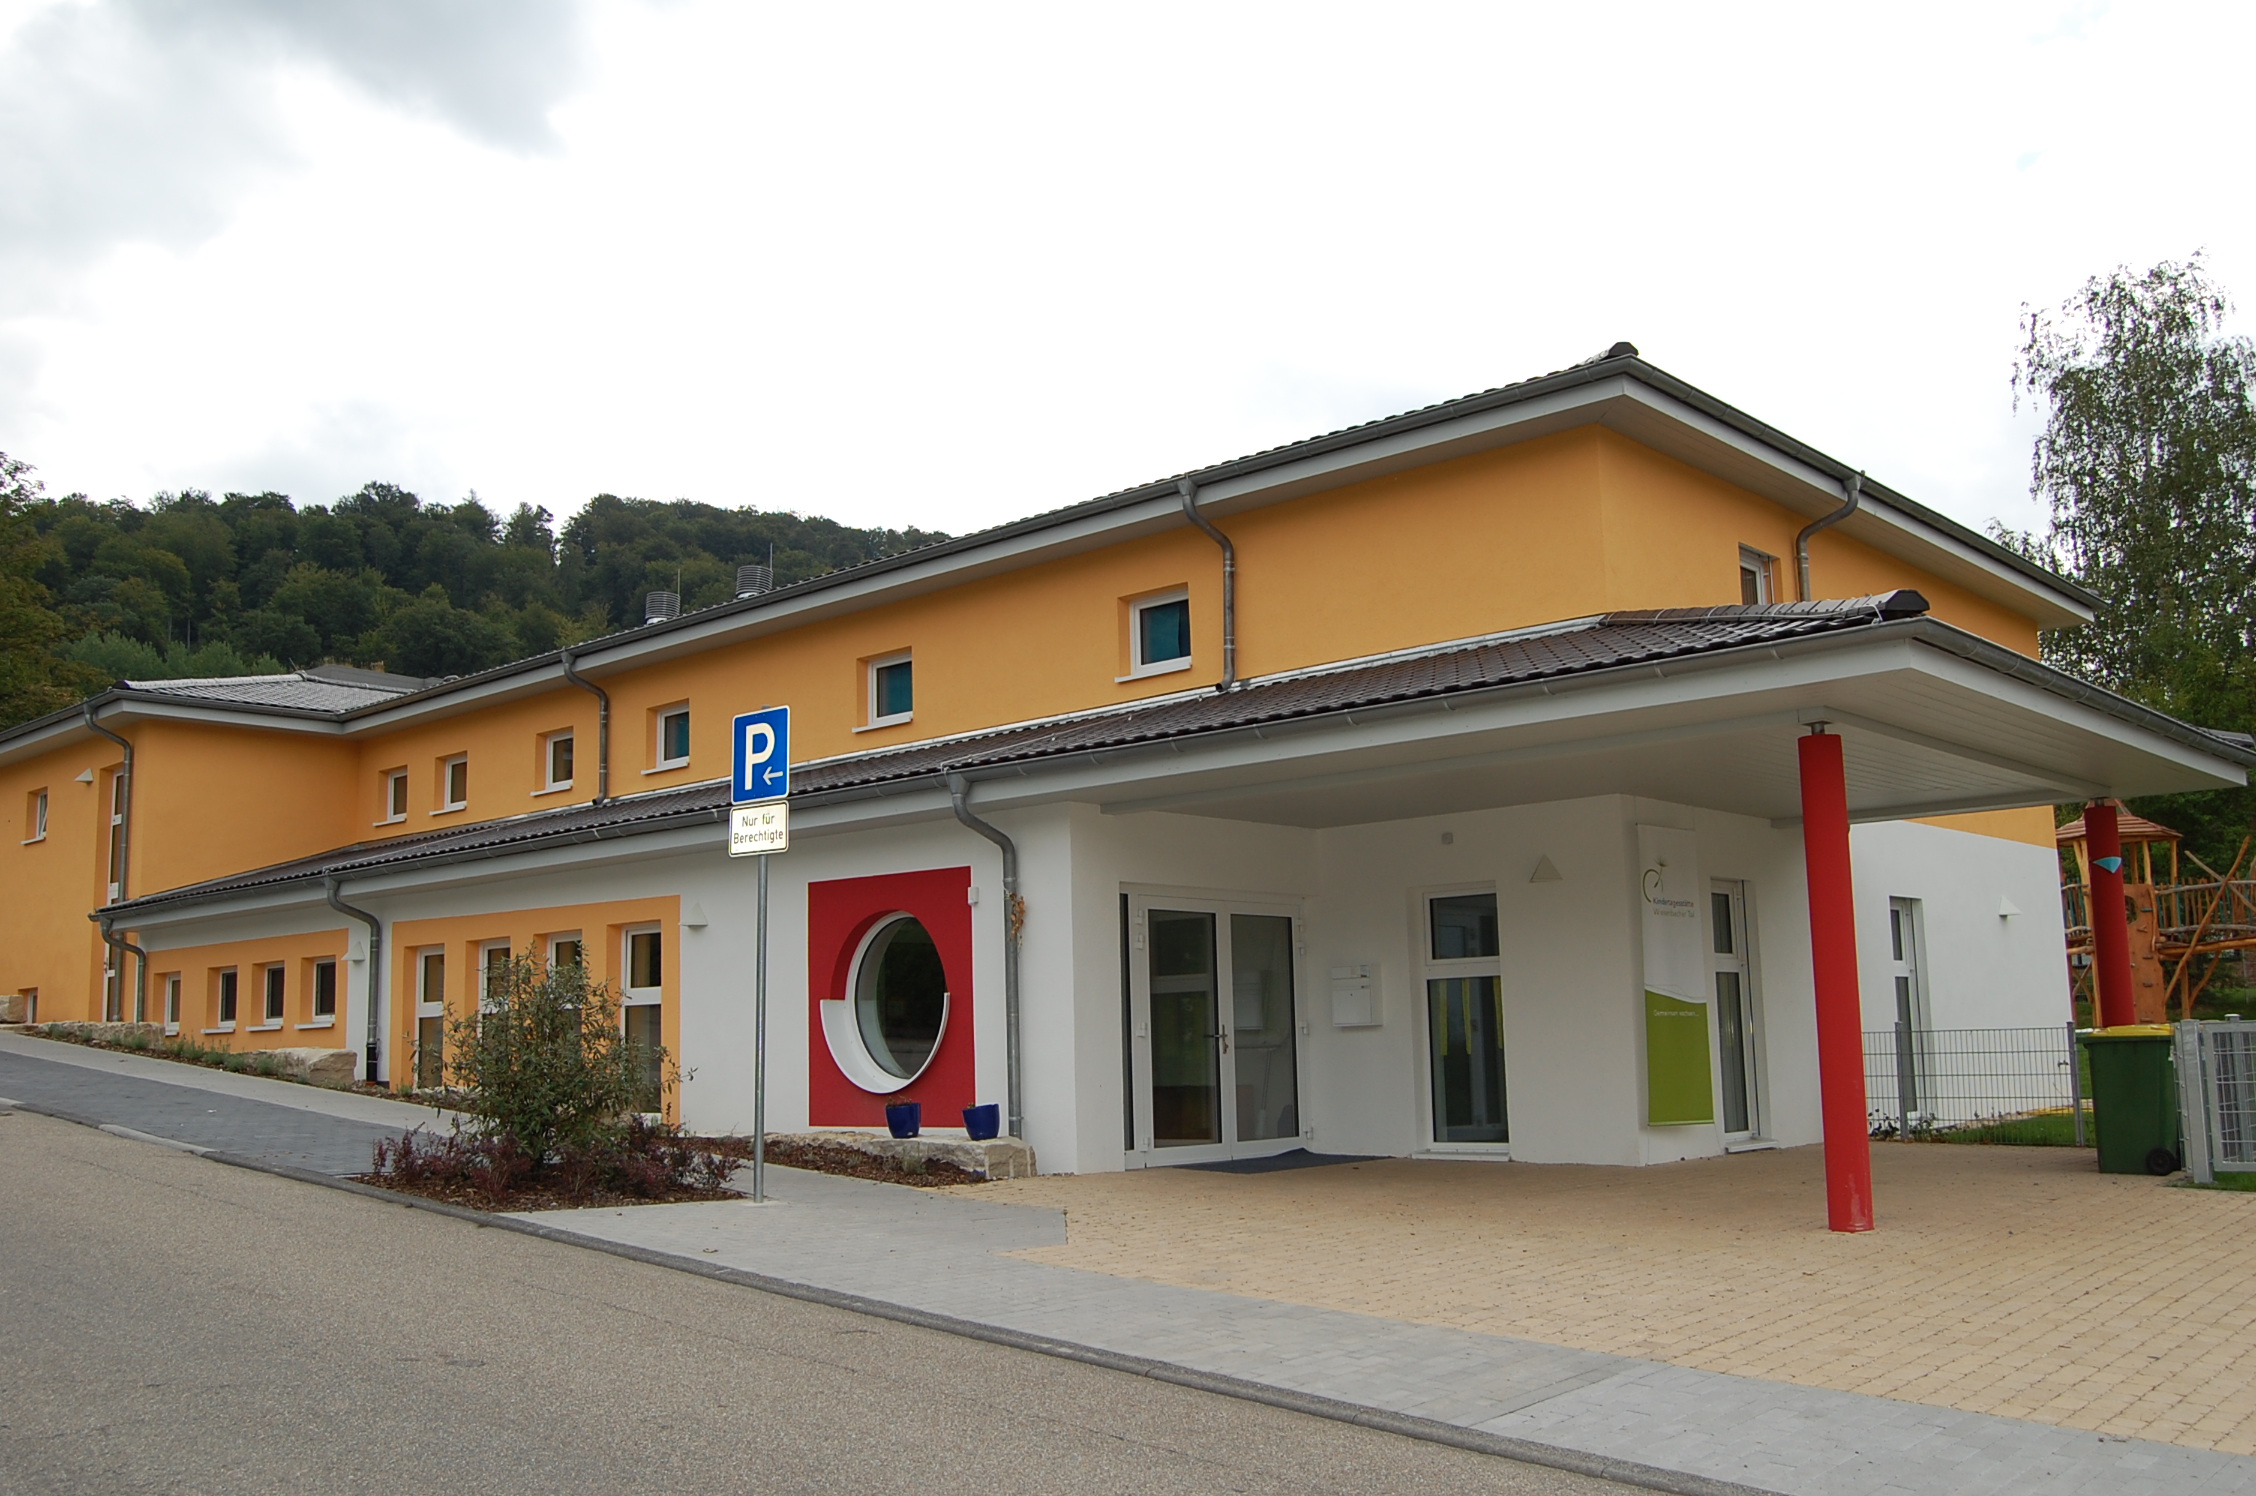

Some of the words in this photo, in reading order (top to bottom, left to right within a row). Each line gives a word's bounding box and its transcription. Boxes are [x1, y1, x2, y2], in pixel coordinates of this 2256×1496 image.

[744, 722, 775, 791] P
[741, 815, 758, 827] Nur
[762, 812, 775, 825] für
[733, 829, 784, 844] Berechtigte
